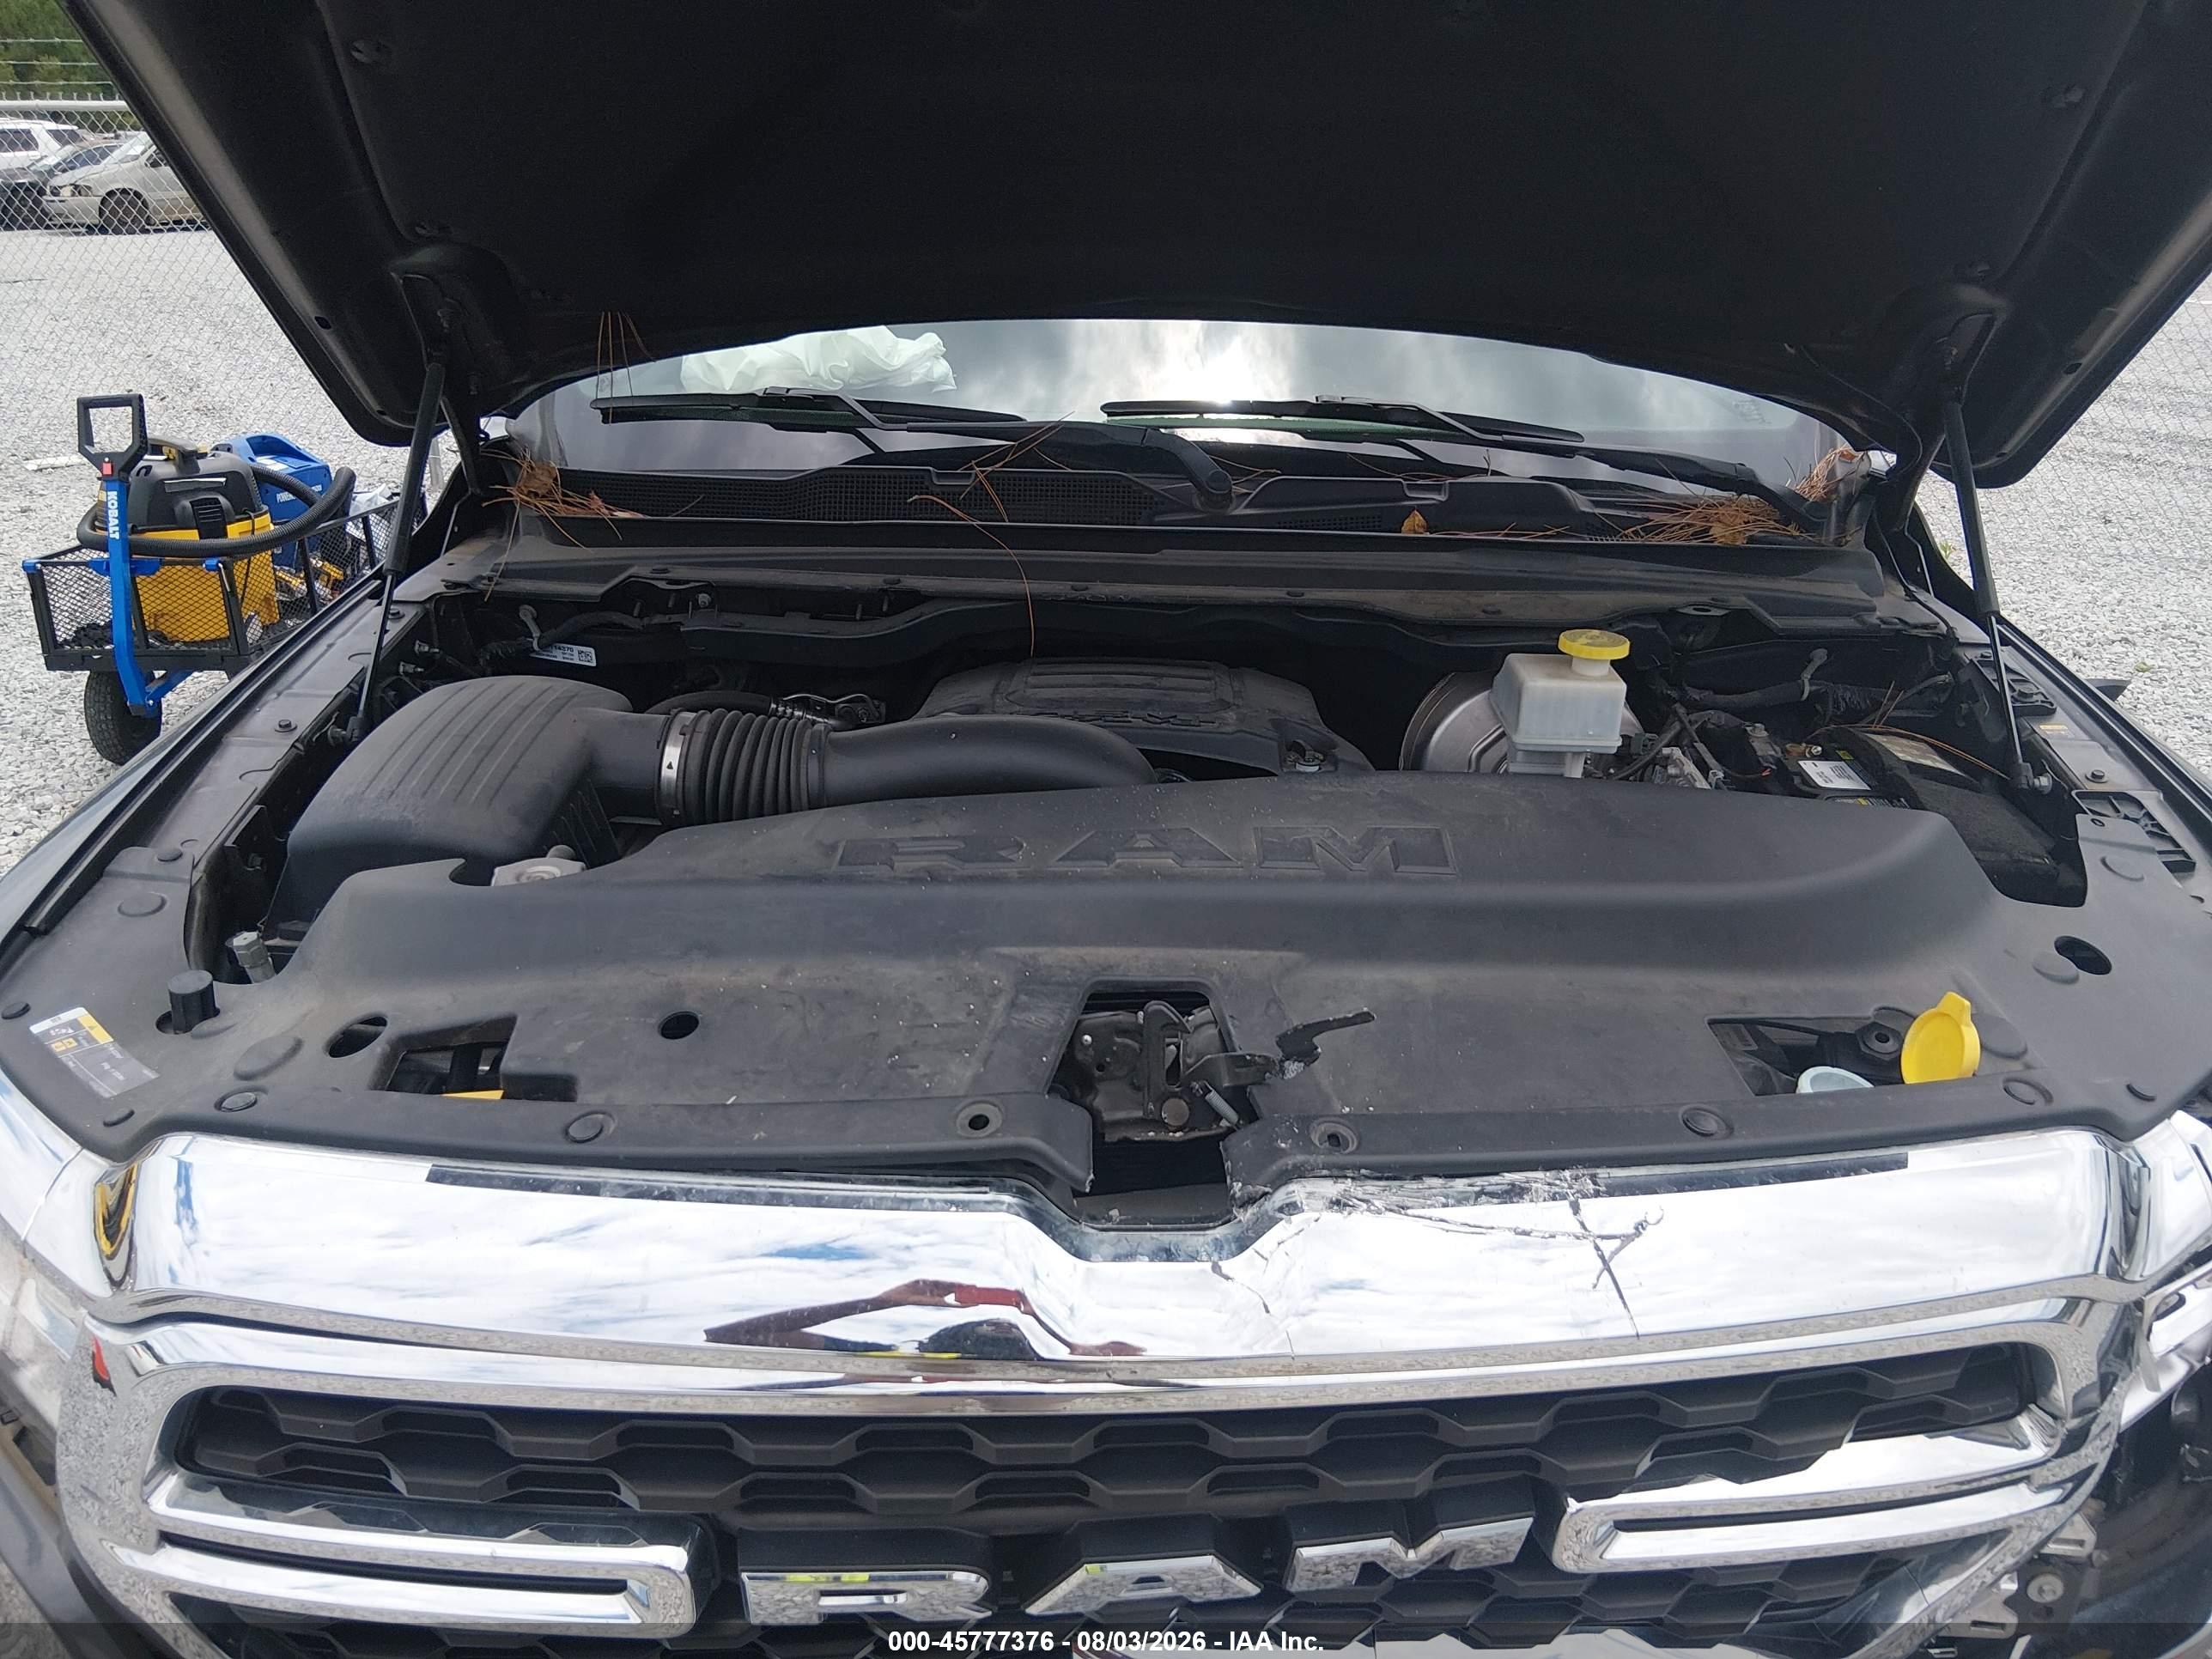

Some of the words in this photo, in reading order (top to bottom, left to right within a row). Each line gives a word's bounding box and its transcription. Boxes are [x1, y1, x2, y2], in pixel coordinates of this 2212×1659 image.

[106, 490, 120, 540] KOBALT
[831, 825, 1460, 876] RAM
[740, 1516, 1534, 1625] RAM
